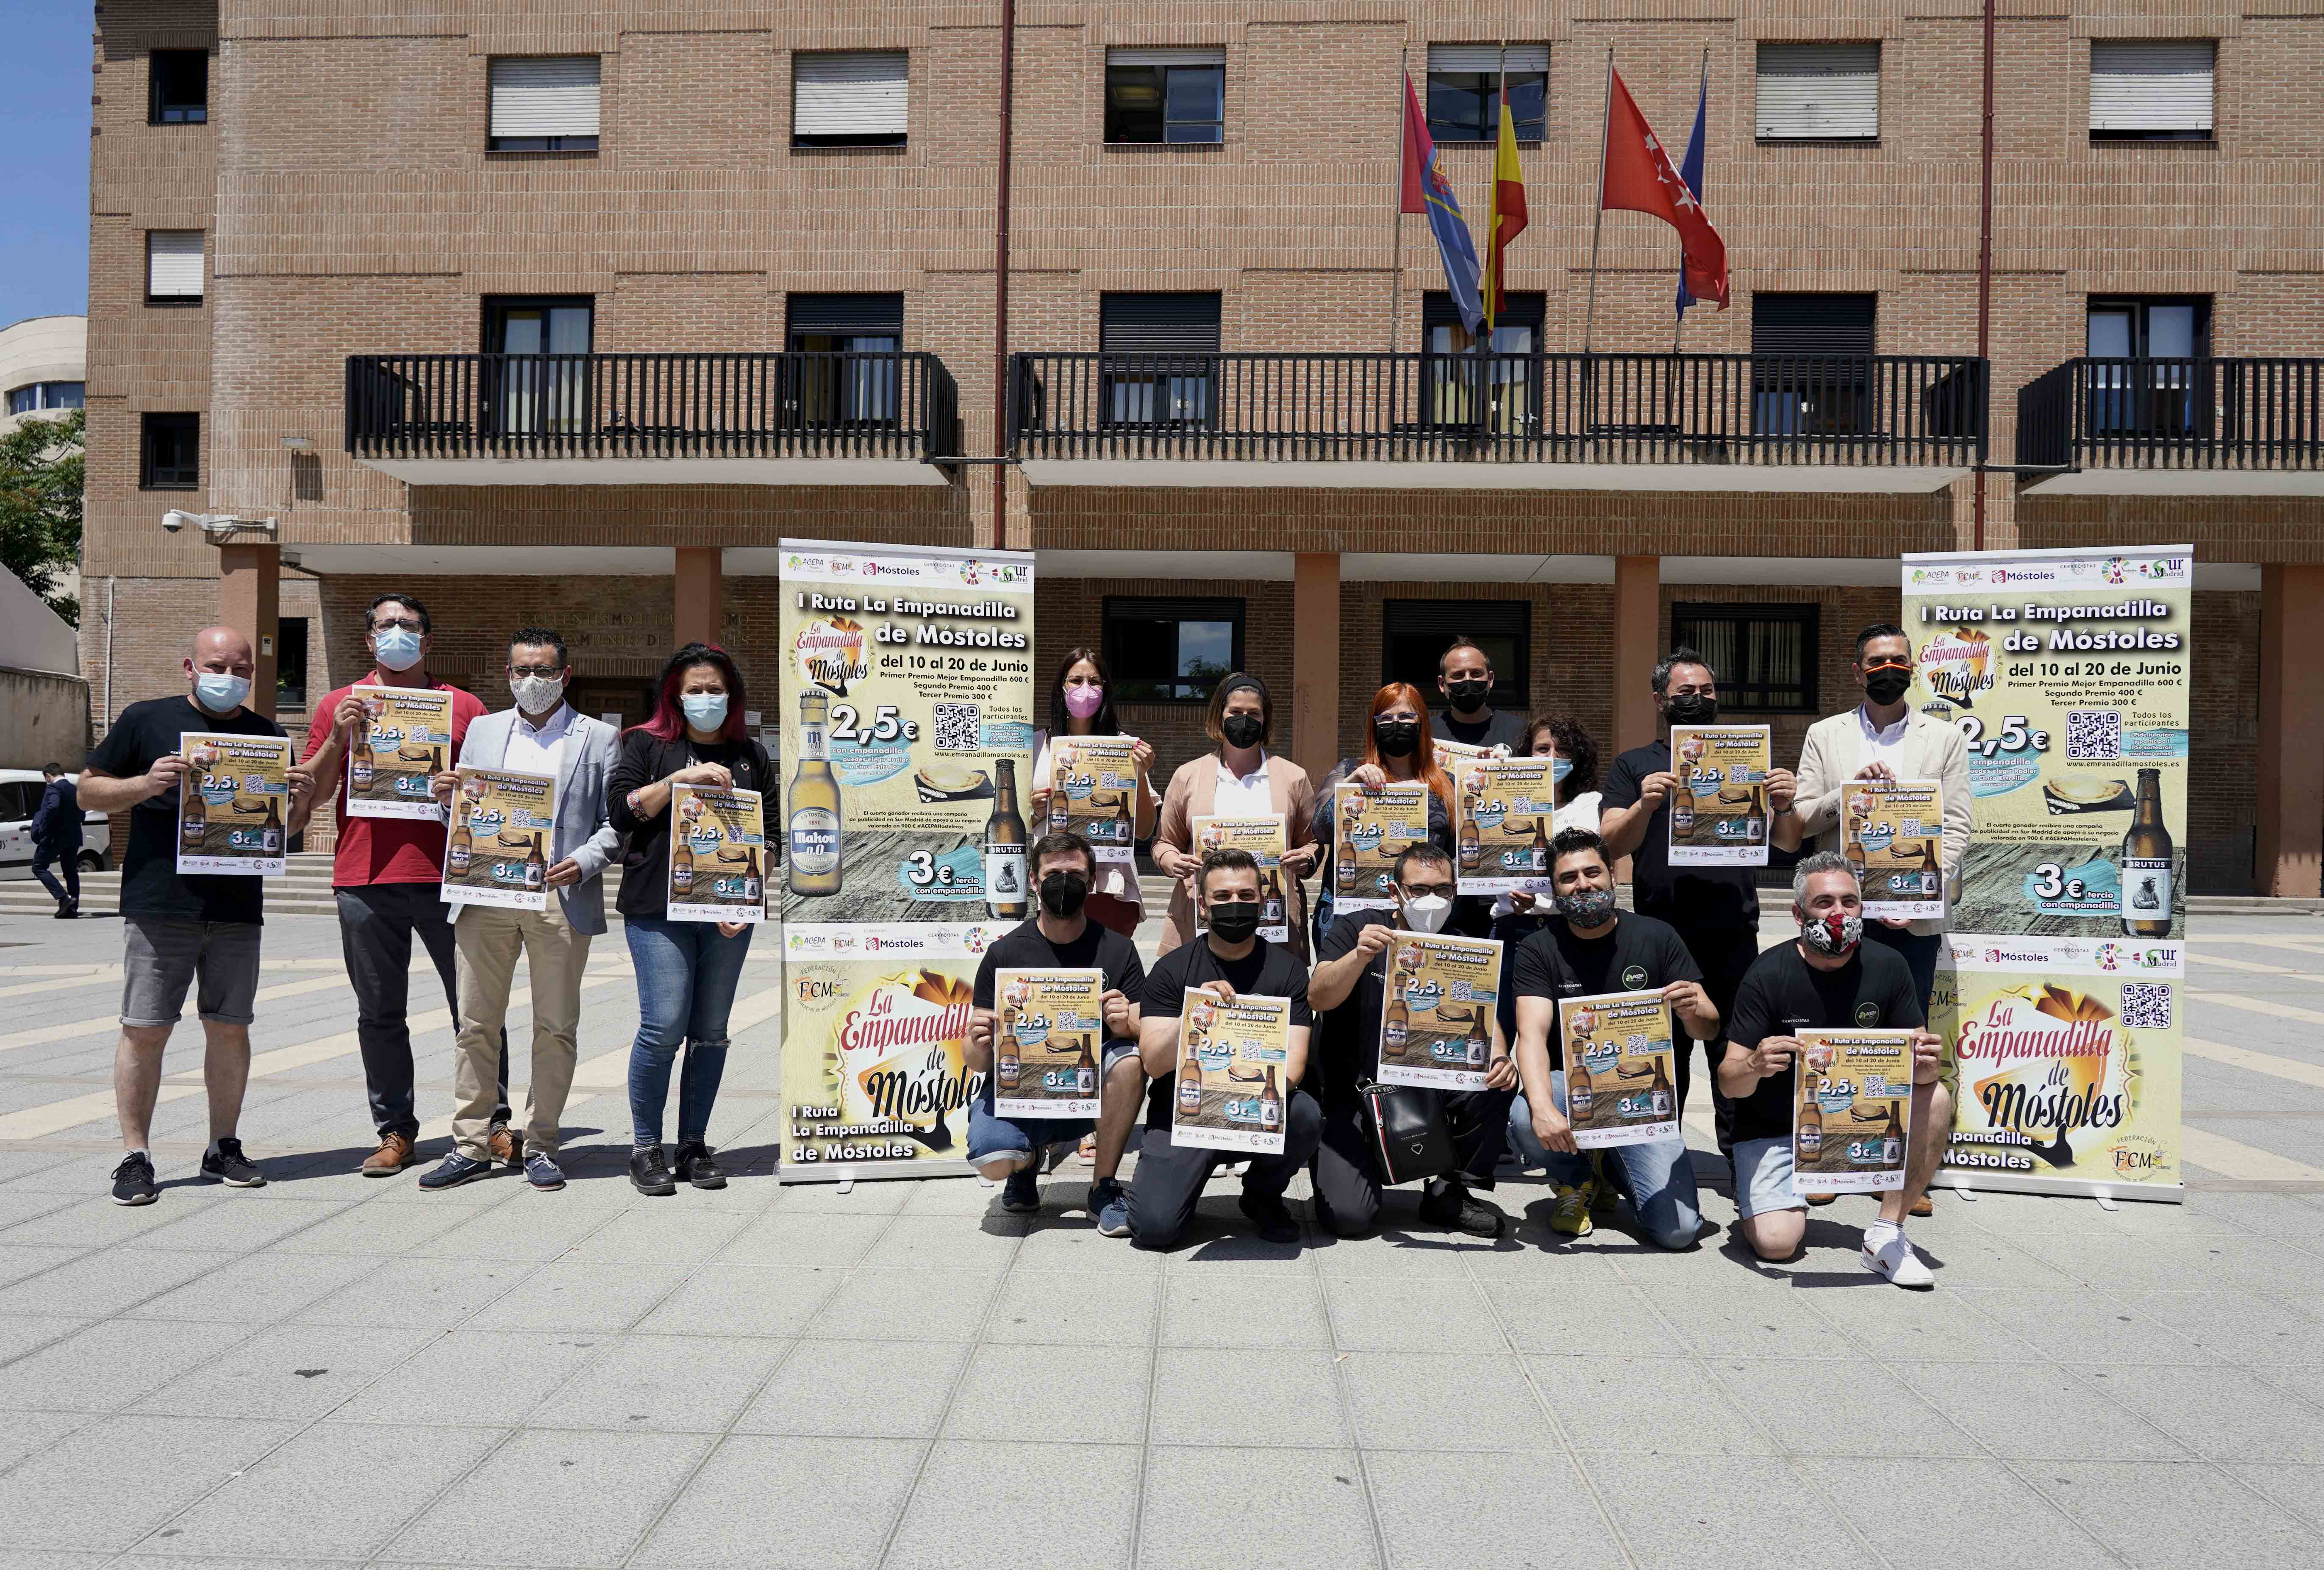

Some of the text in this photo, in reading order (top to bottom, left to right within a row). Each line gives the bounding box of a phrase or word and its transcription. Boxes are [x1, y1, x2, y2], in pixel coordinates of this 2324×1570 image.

[877, 566, 919, 575] Móstoles
[1003, 572, 1027, 583] Madrid
[2007, 571, 2055, 581] Móstoles
[2154, 568, 2184, 577] Madrid
[797, 592, 1016, 617] I Ruta La Empanadilla
[1921, 599, 2167, 622] I Ruta La Empanadilla
[810, 621, 821, 635] La
[875, 621, 1025, 648] de Móstoles
[797, 631, 863, 652] Empanadilla
[2003, 627, 2179, 651] de Móstoles
[836, 649, 845, 661] de
[809, 659, 868, 682] Móstoles
[880, 655, 1029, 672] del 10 al 20 de Junio
[913, 682, 947, 690] Segundo
[242, 750, 278, 758] Móstoles
[509, 784, 544, 794] Móstoles
[725, 802, 753, 811] Móstoles
[794, 832, 836, 843] Mahou
[2128, 860, 2166, 868] BRUTUS
[955, 876, 979, 885] tercio
[932, 887, 985, 896] empanadilla
[880, 939, 924, 949] Móstoles
[1451, 944, 1494, 955] Empanadilla
[1435, 952, 1488, 964] de Móstoles
[800, 965, 836, 975] FEDERACIÓN
[800, 982, 832, 998] FCM
[1053, 985, 1089, 993] Móstoles
[868, 988, 893, 1017] La
[1621, 1007, 1658, 1017] Móstoles
[1986, 1000, 2013, 1028] La
[841, 1001, 970, 1057] Empanadill
[1956, 1019, 2115, 1068] Empanadilla
[927, 1044, 945, 1071] de
[1860, 1047, 1899, 1056] Móstoles
[2047, 1060, 2069, 1087] de
[867, 1064, 981, 1118] Móstole
[792, 1105, 838, 1118] I Ruta
[1983, 1082, 2125, 1129] Móstoles
[792, 1121, 913, 1138] La Empanadilla
[1948, 1131, 2032, 1145] panadilla
[792, 1141, 913, 1161] de Móstoles
[1942, 1148, 2031, 1169] Móstoles
[2115, 1151, 2152, 1168] FCM
